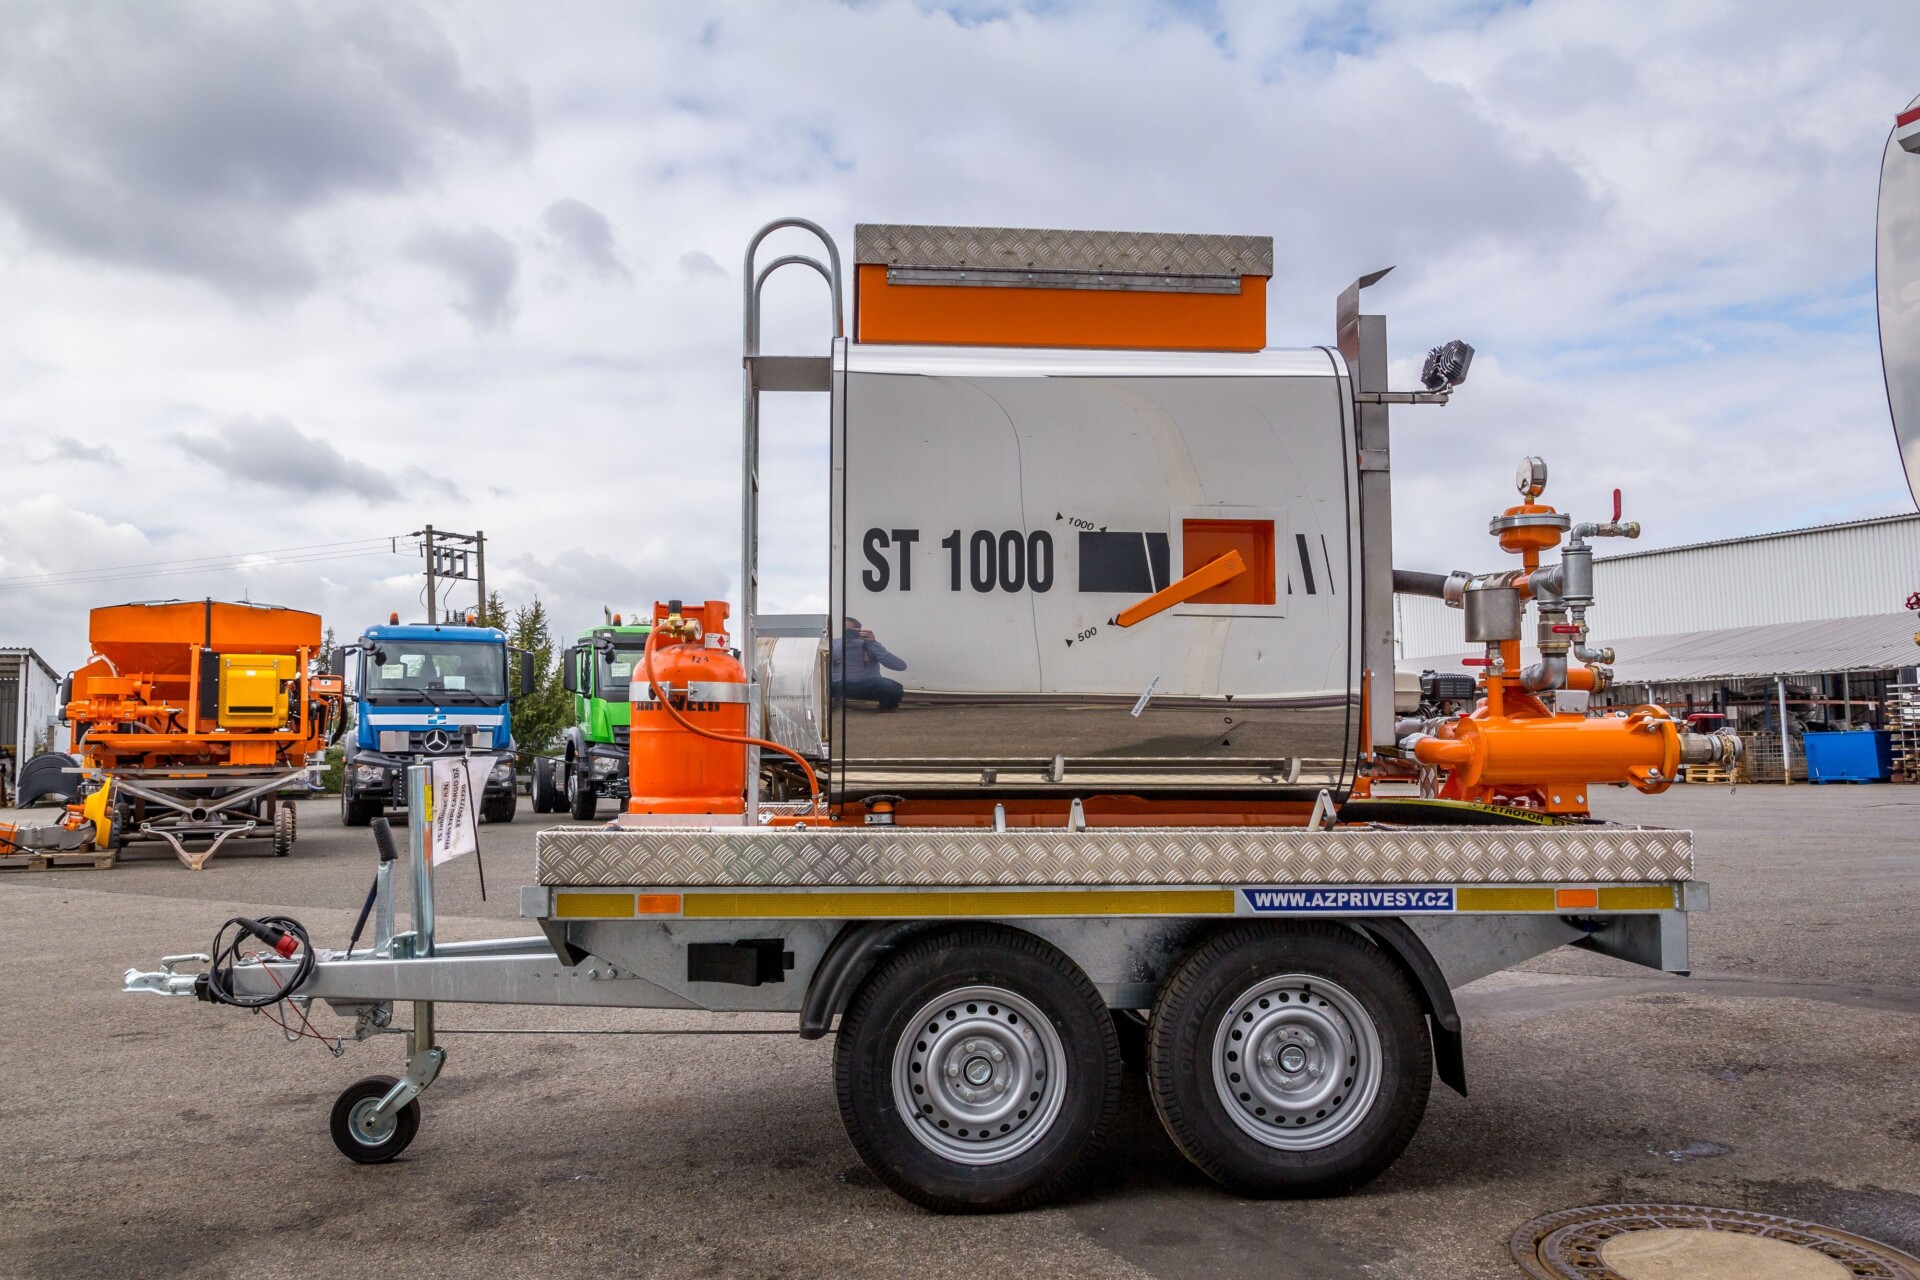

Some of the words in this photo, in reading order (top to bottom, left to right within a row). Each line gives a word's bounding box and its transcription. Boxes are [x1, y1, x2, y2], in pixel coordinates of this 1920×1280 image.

[1068, 517, 1095, 531] 1000
[862, 527, 919, 593] ST
[942, 529, 1054, 593] 1000
[1077, 626, 1098, 643] 500
[1223, 716, 1233, 724] 0
[451, 780, 459, 807] CARGO
[1483, 804, 1544, 822] PETROFOR
[1254, 892, 1449, 907] WWW.AZPRIVESY.CZ
